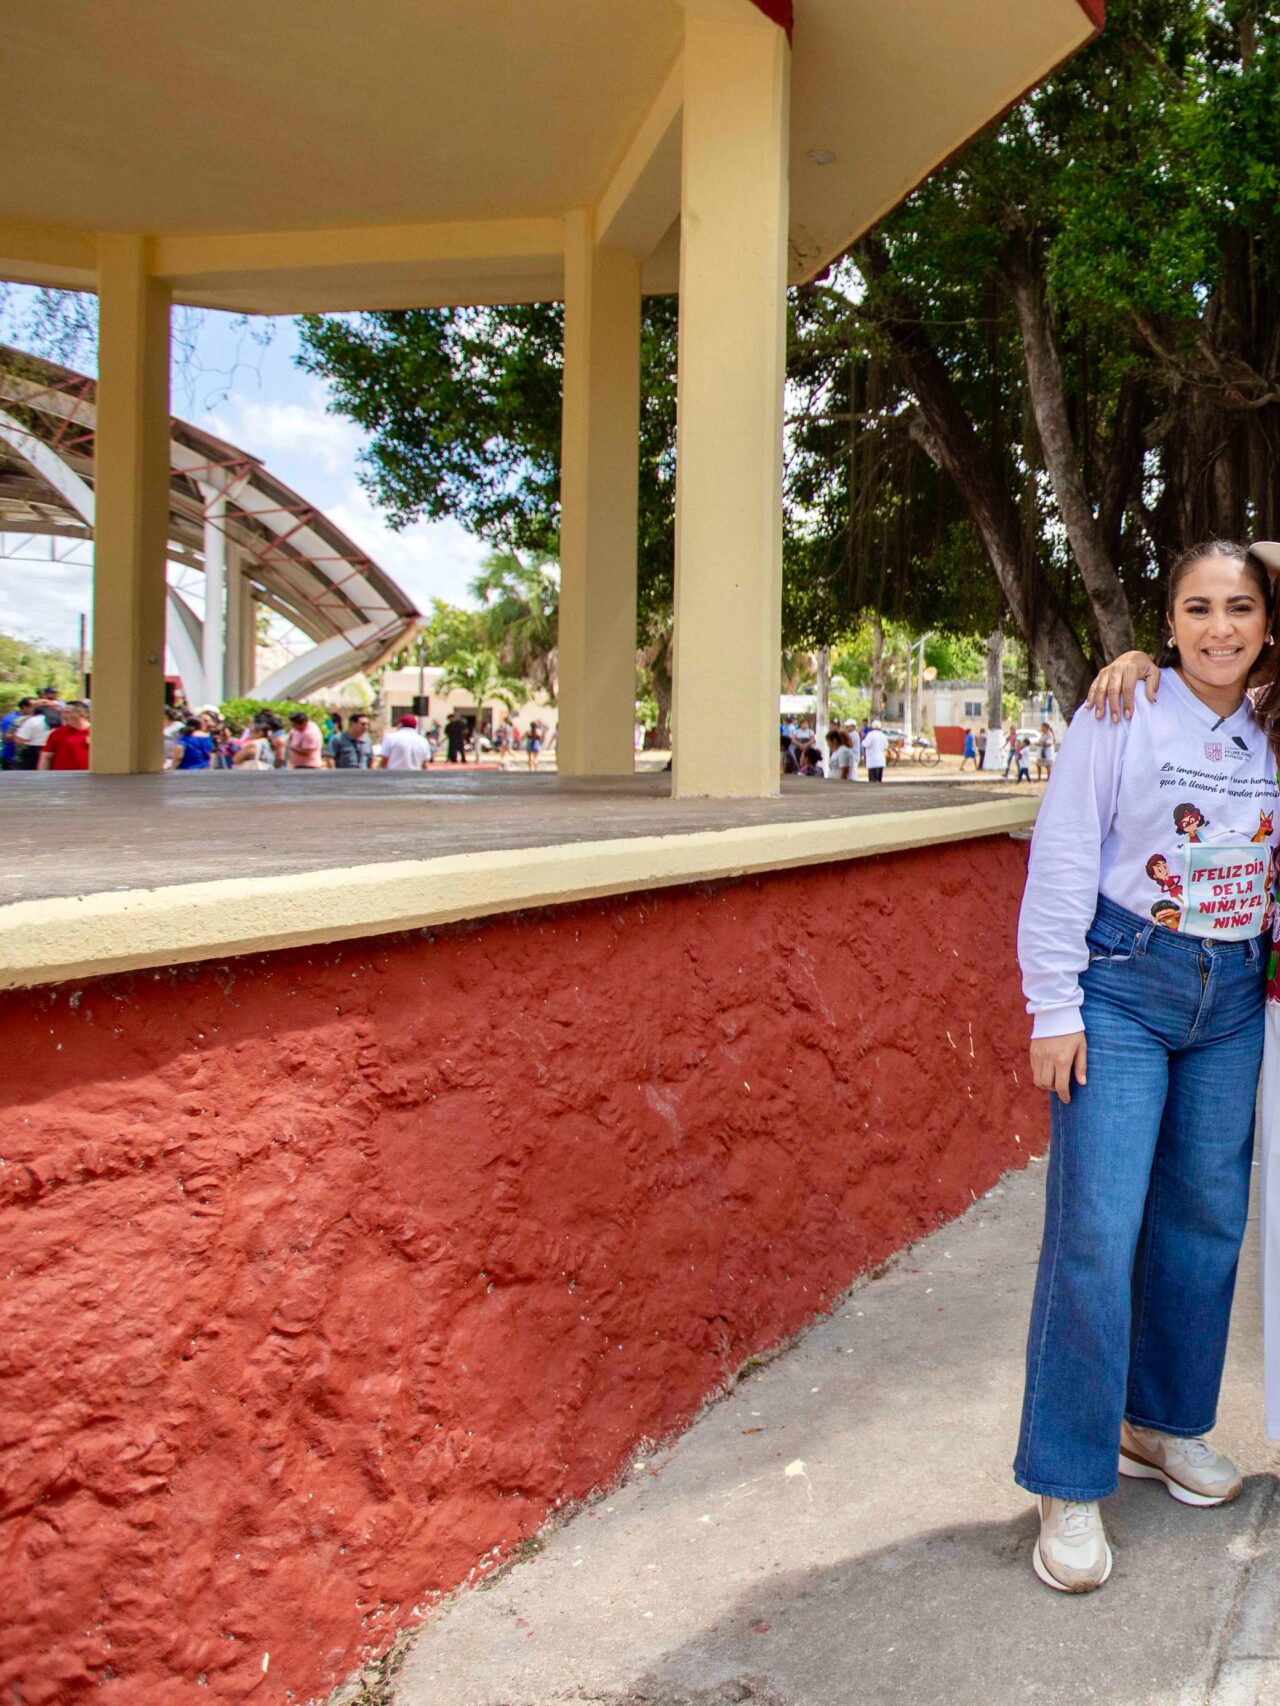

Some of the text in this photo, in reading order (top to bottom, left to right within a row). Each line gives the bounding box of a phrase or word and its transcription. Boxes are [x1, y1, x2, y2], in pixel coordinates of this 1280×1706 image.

[1176, 765, 1228, 781] imaginación
[1160, 778, 1176, 788] que
[1178, 778, 1187, 786] te
[1188, 780, 1218, 793] llevará
[1191, 858, 1264, 882] ¡FELIZ DÍA
[1212, 880, 1253, 896] DE LA
[1199, 894, 1262, 914] NIÑA Y EL
[1213, 911, 1252, 928] NIÑO!
